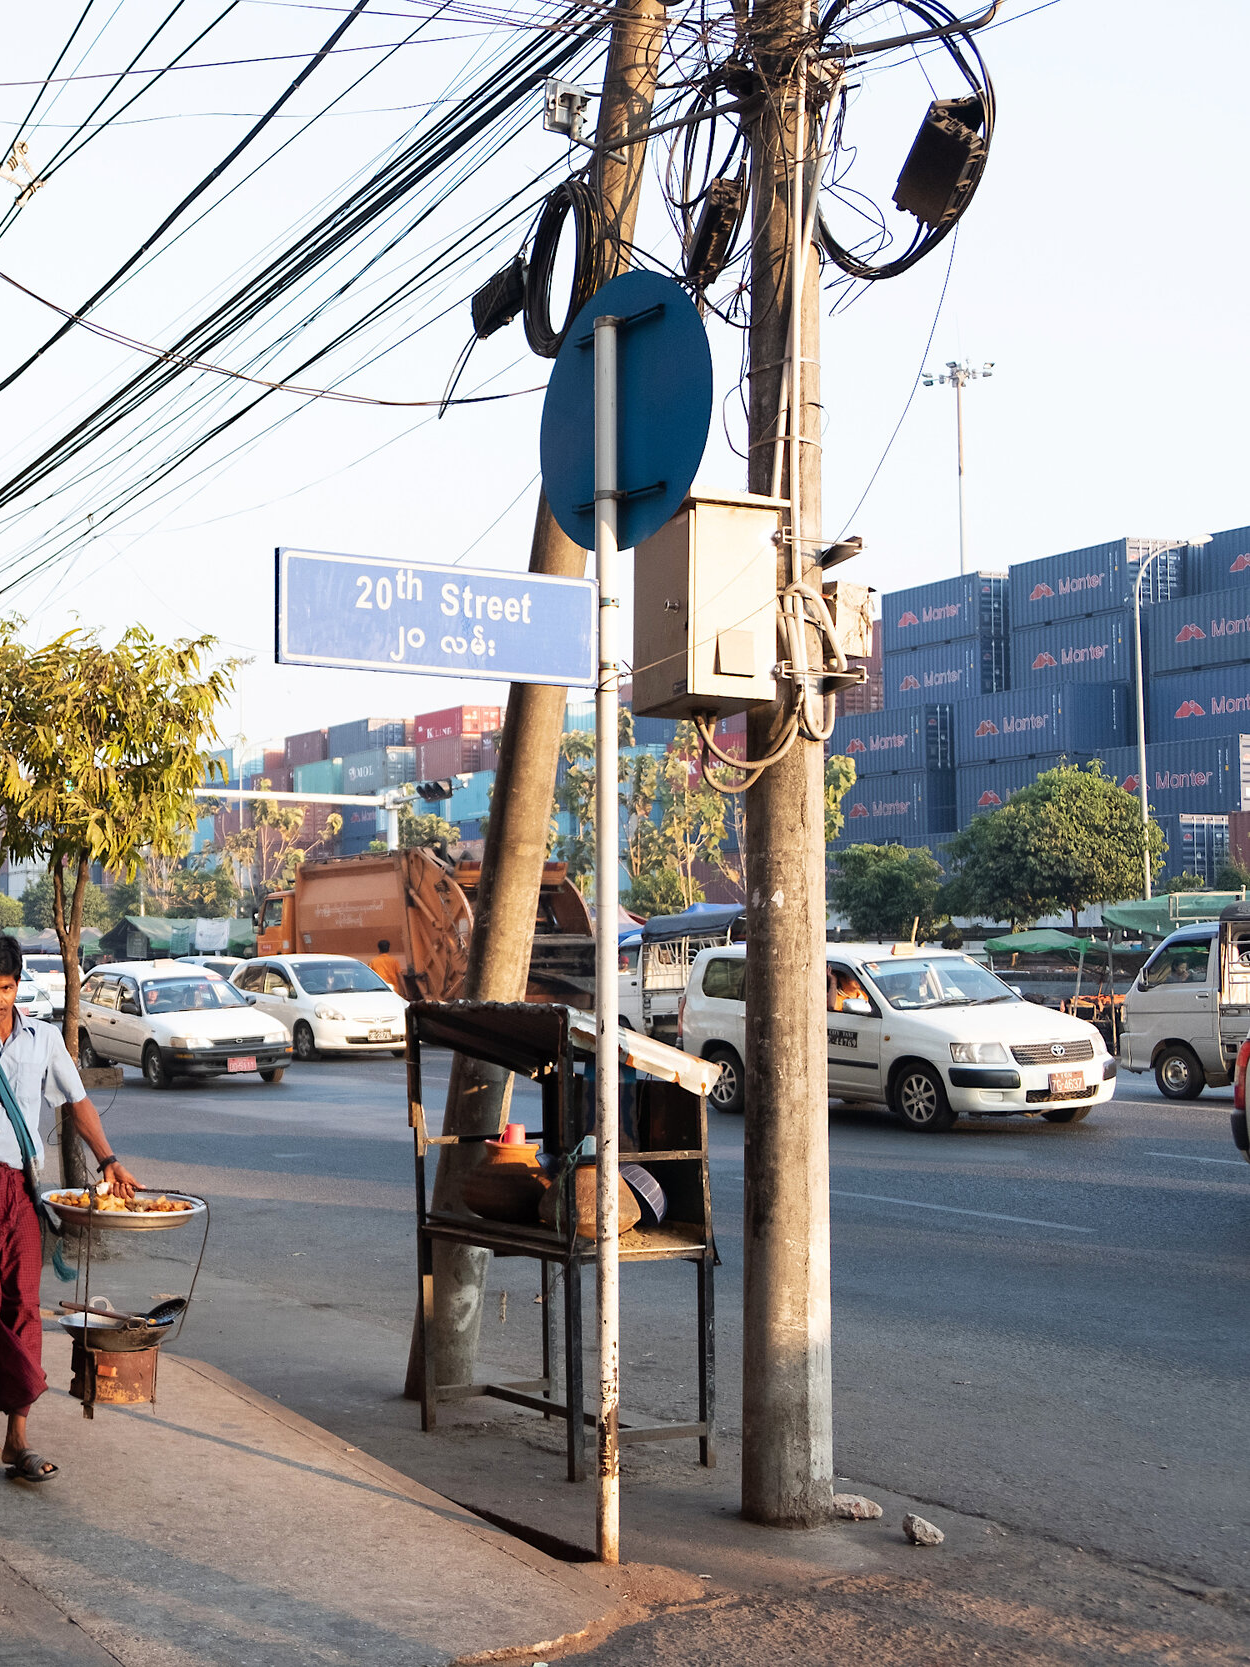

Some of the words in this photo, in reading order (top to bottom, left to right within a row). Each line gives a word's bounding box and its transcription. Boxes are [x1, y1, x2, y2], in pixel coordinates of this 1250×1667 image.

[355, 568, 423, 611] 20th
[440, 582, 532, 624] Street
[440, 624, 496, 657] လမ်း
[356, 765, 375, 778] MOL
